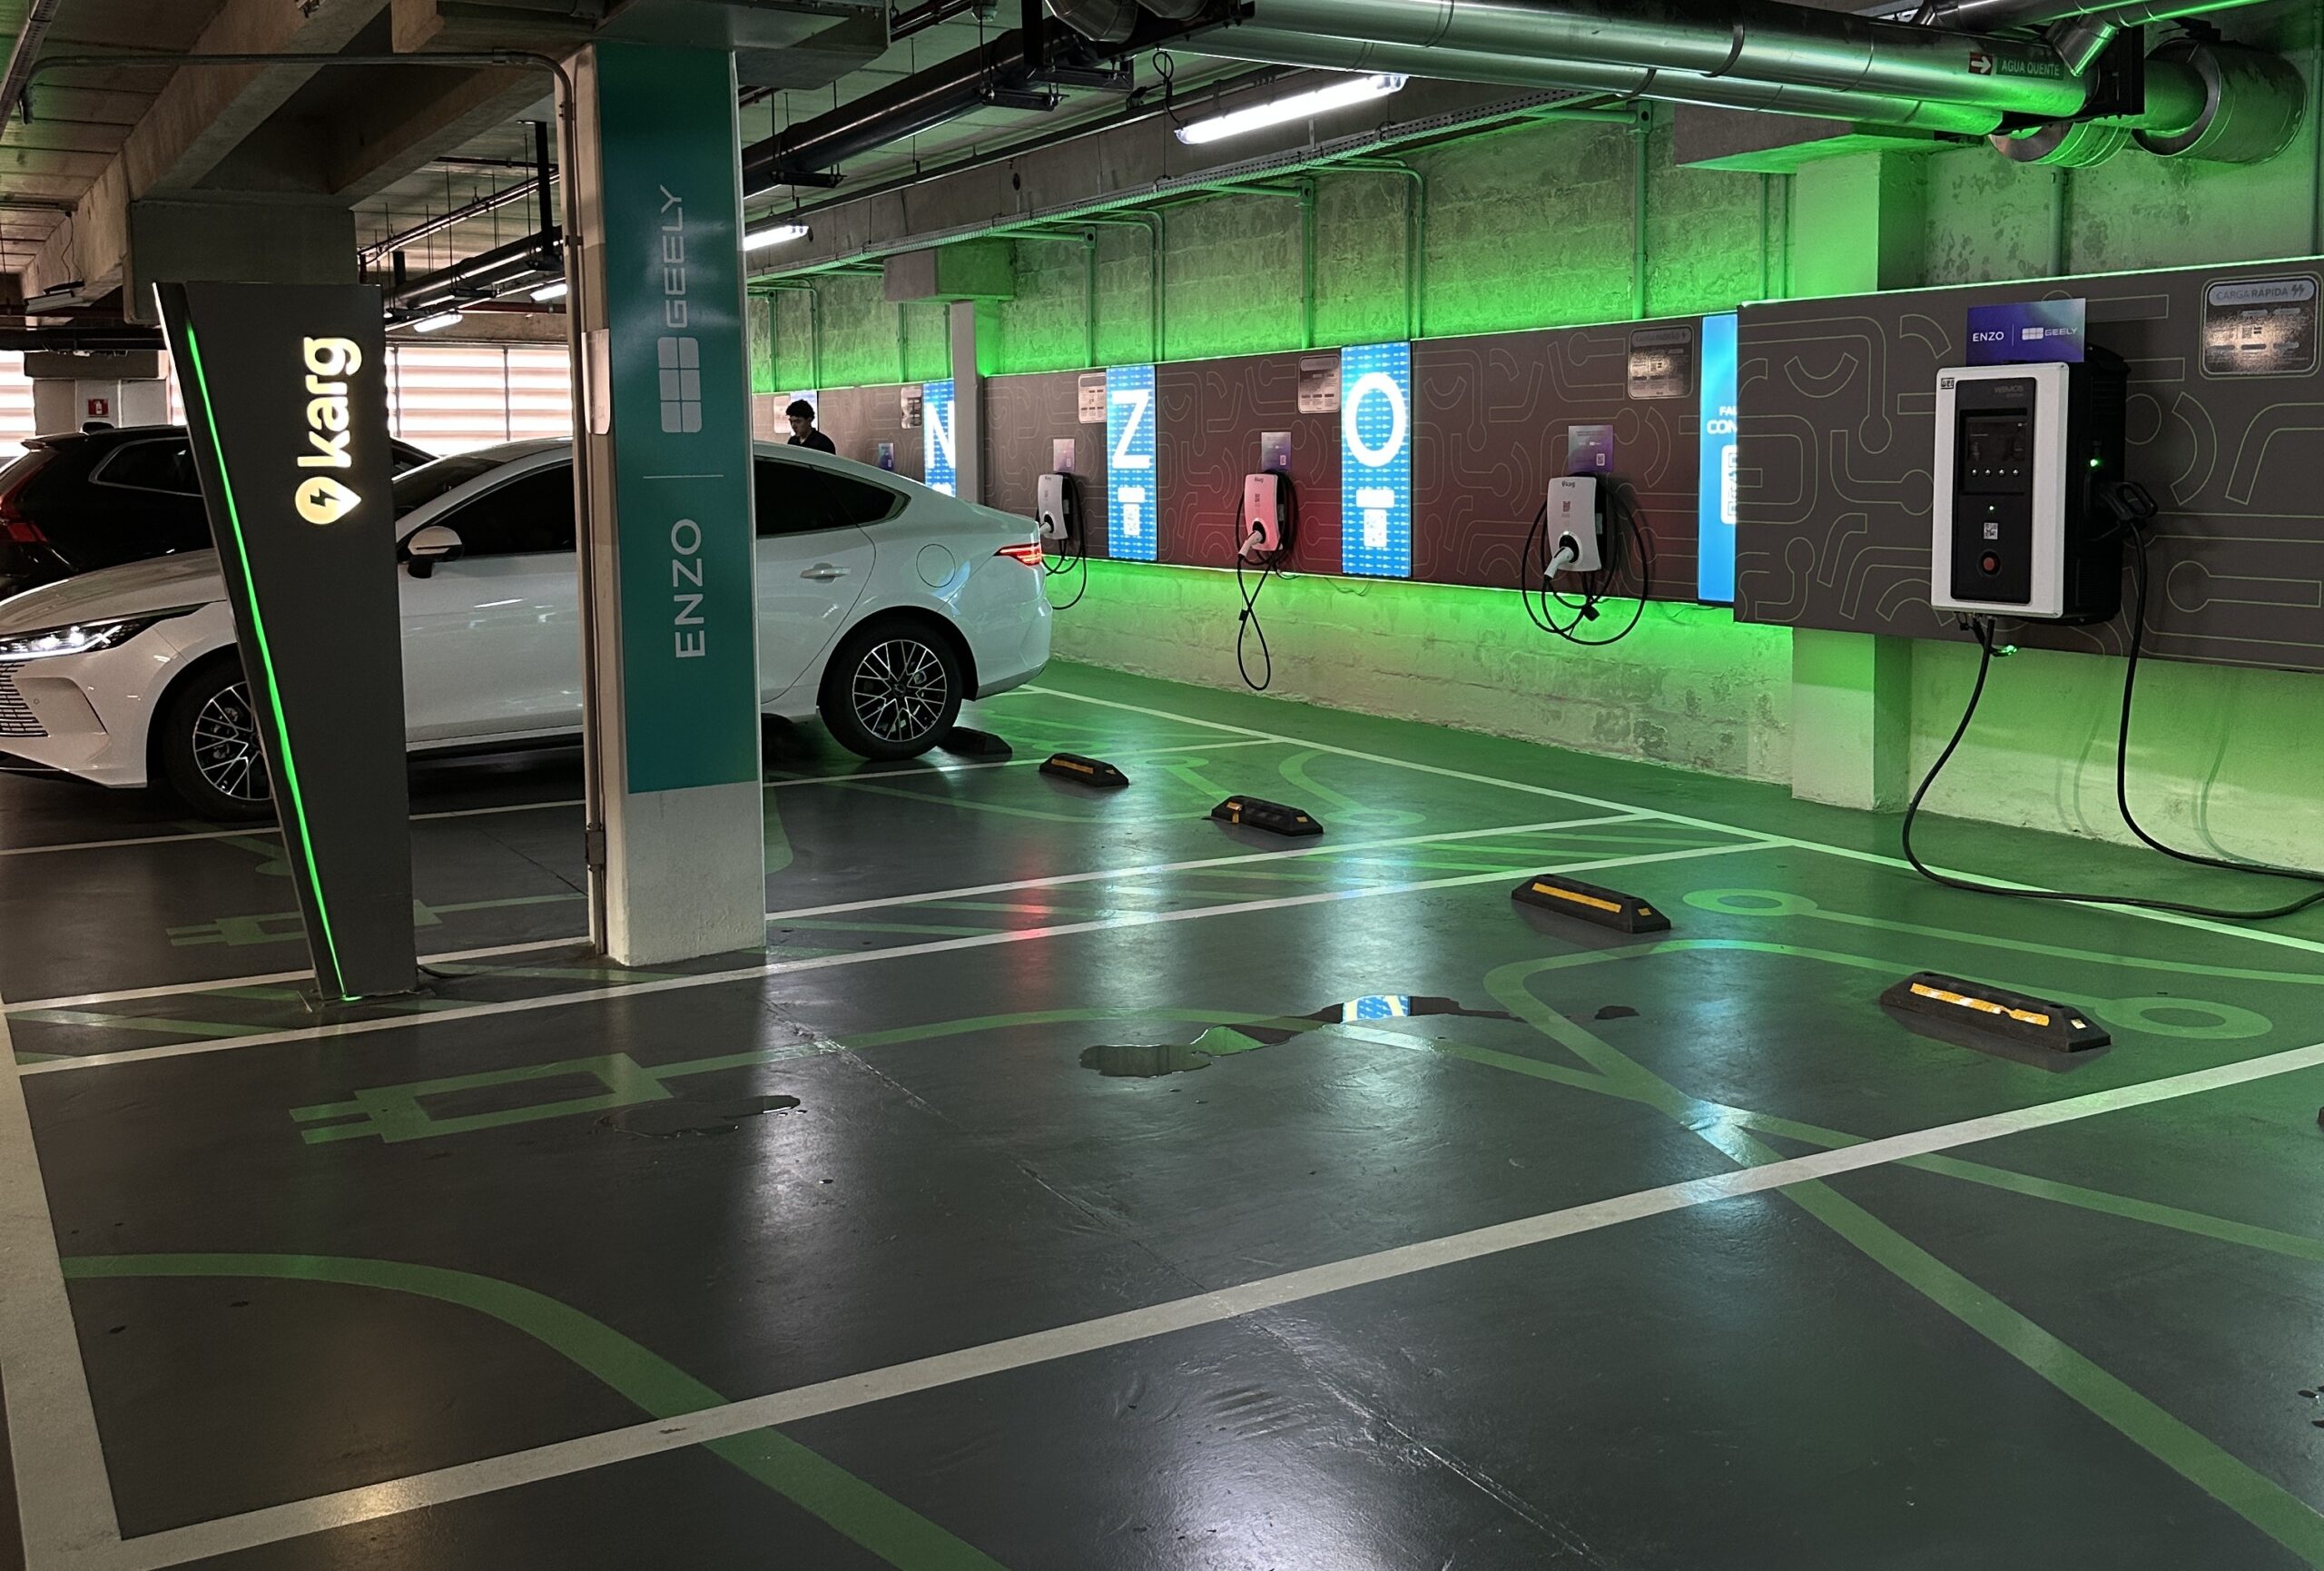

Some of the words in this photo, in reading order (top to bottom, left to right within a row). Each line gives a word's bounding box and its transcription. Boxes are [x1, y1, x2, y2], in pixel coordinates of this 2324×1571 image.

[2026, 62, 2060, 76] QUENTE
[659, 184, 687, 328] GEELY
[2216, 290, 2250, 301] CARGA
[1972, 331, 2004, 342] ENZO
[2044, 327, 2078, 337] GEELY
[297, 337, 362, 468] karg
[926, 400, 956, 469] N
[1111, 389, 1151, 469] Z
[1344, 371, 1406, 468] O
[671, 519, 705, 657] ENZO
